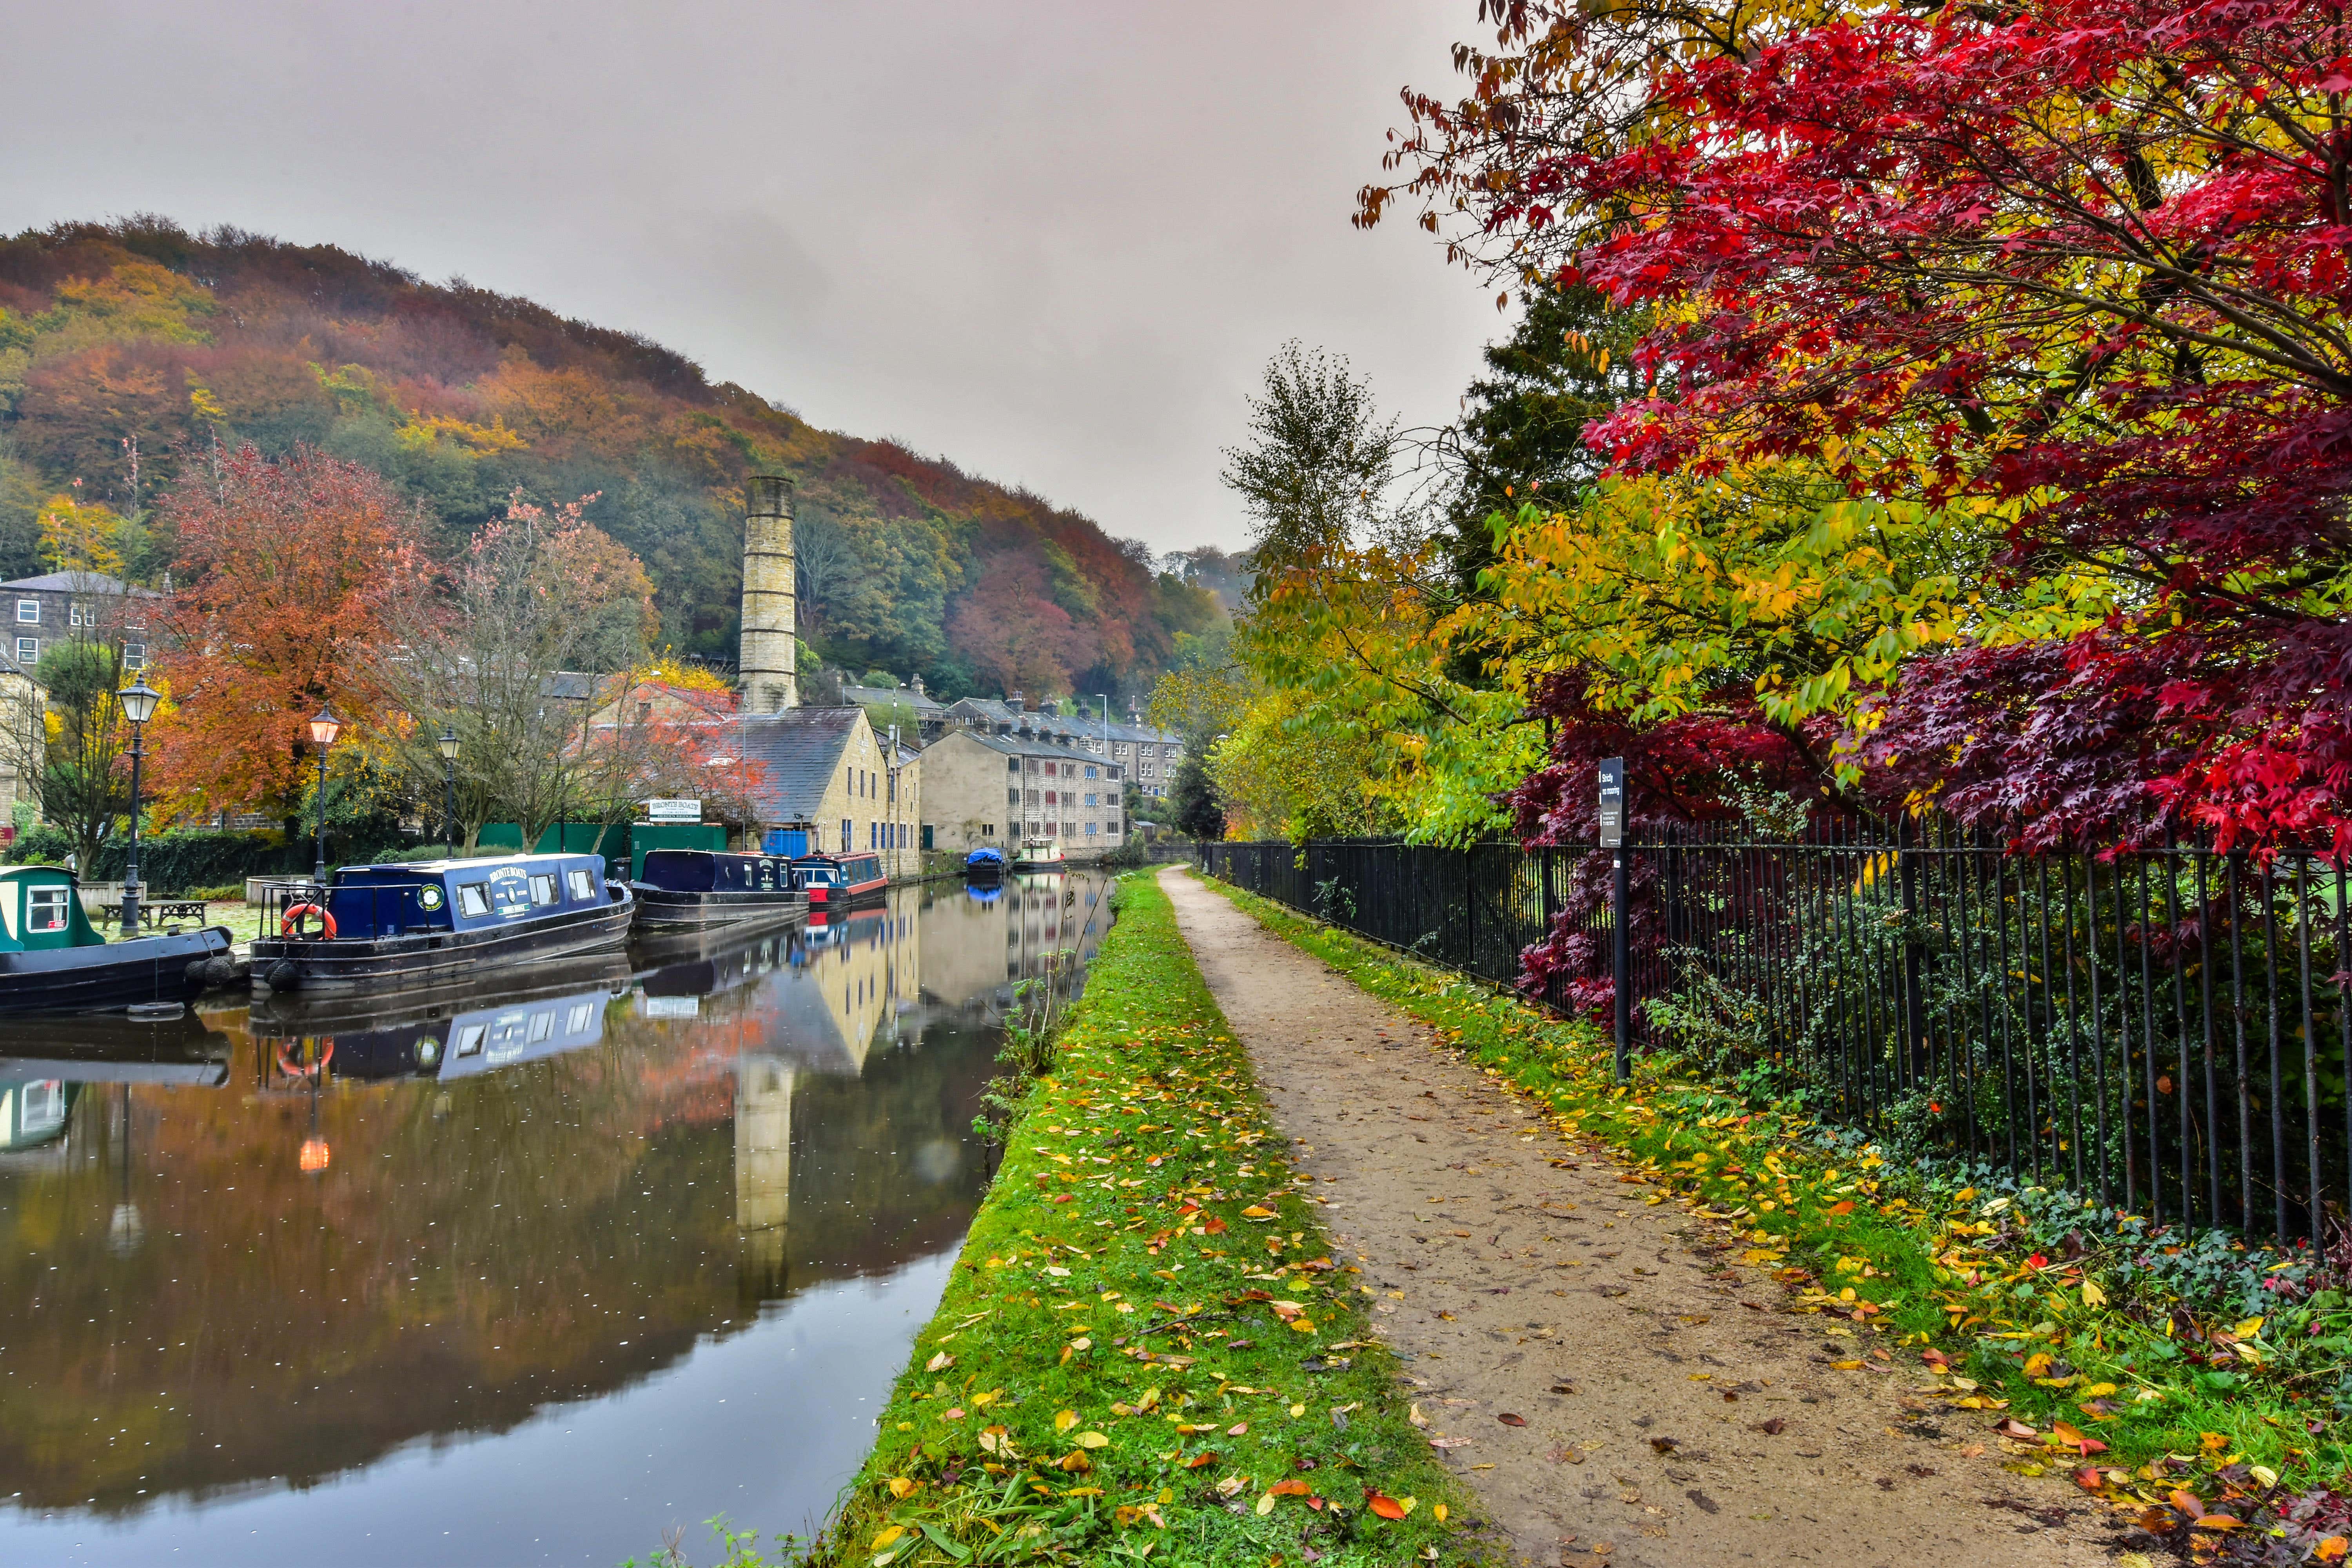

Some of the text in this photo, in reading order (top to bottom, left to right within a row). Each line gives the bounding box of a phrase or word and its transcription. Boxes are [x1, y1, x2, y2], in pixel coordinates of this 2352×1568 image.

[1602, 773, 1613, 783] Strictly
[1607, 786, 1619, 795] mooring
[679, 802, 698, 810] BOATS
[489, 867, 527, 884] BRONTE BOATS
